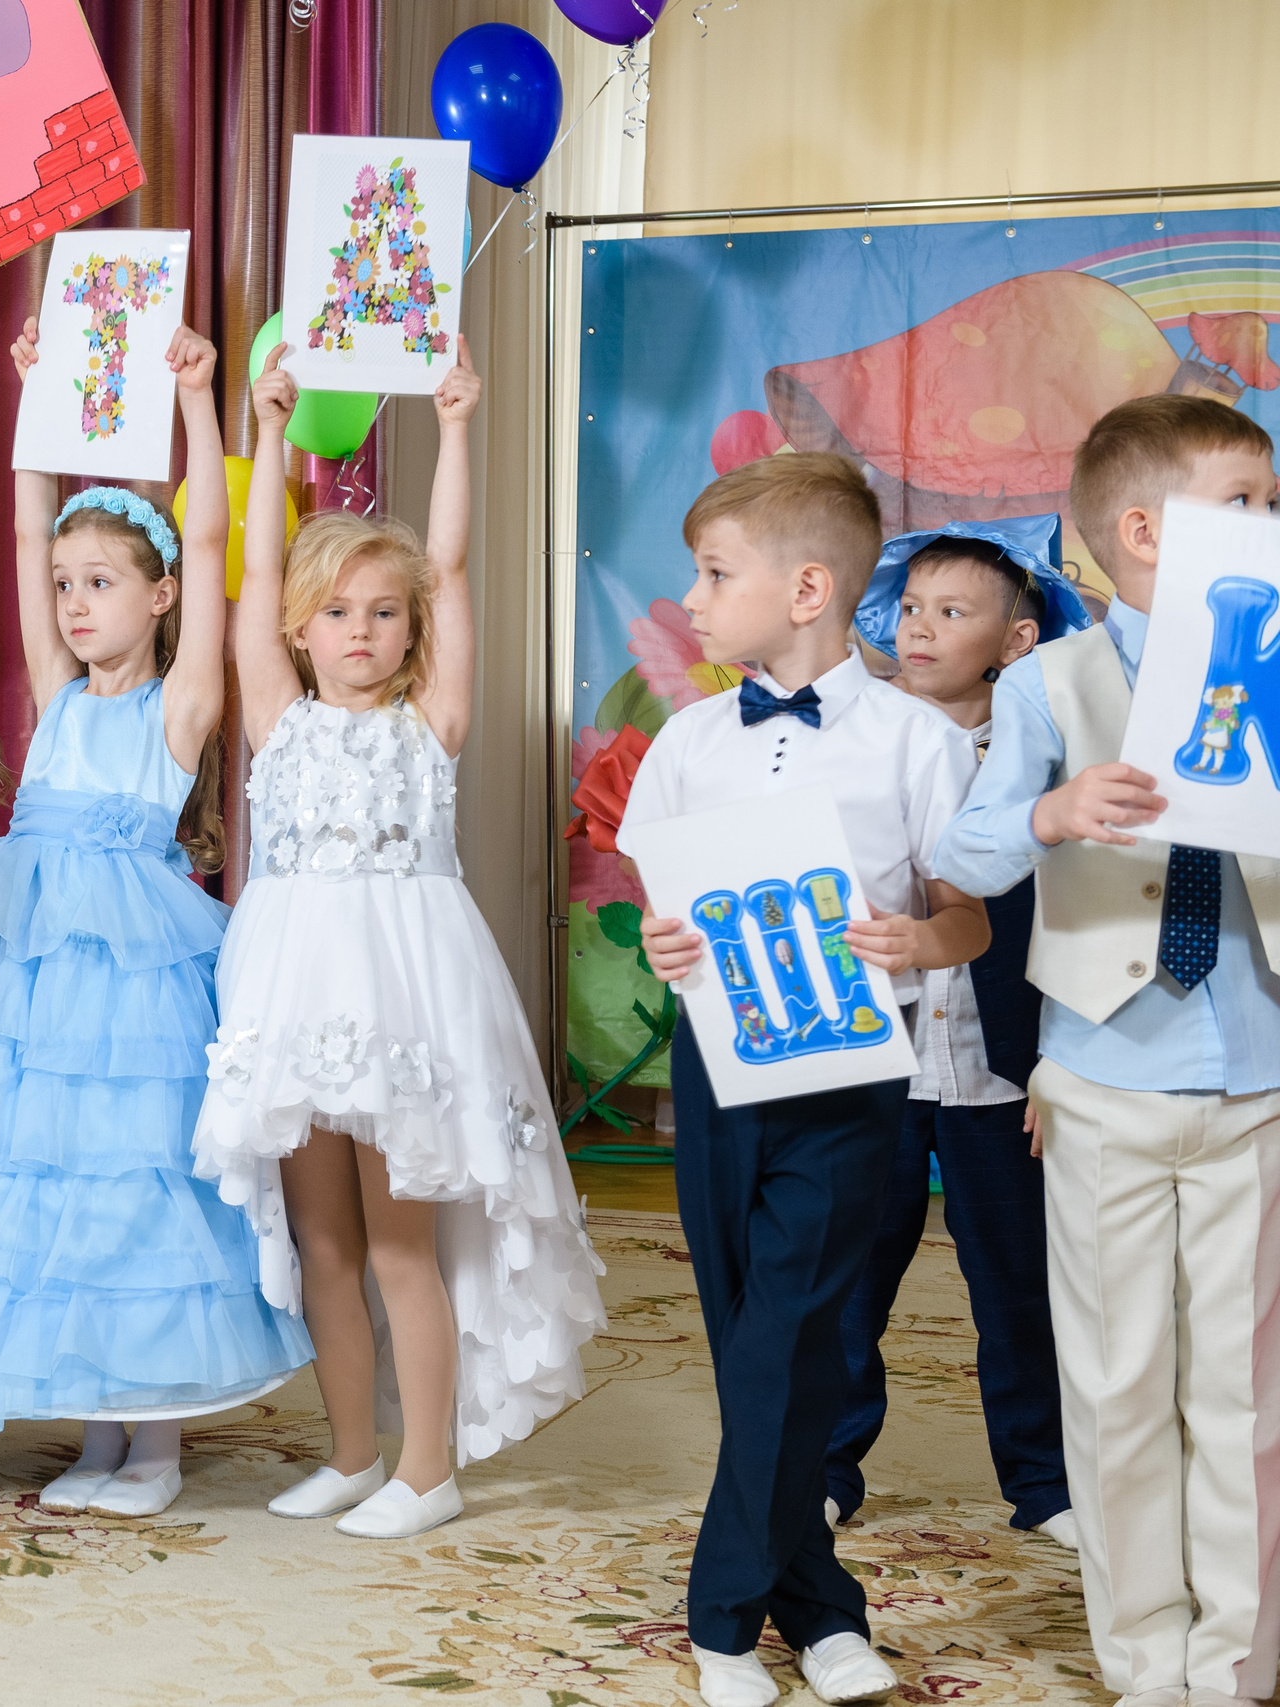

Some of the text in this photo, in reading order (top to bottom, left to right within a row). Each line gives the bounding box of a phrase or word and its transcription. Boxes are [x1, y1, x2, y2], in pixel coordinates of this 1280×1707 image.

[63, 250, 173, 441] Т
[308, 158, 450, 364] А
[691, 867, 893, 1065] Ш
